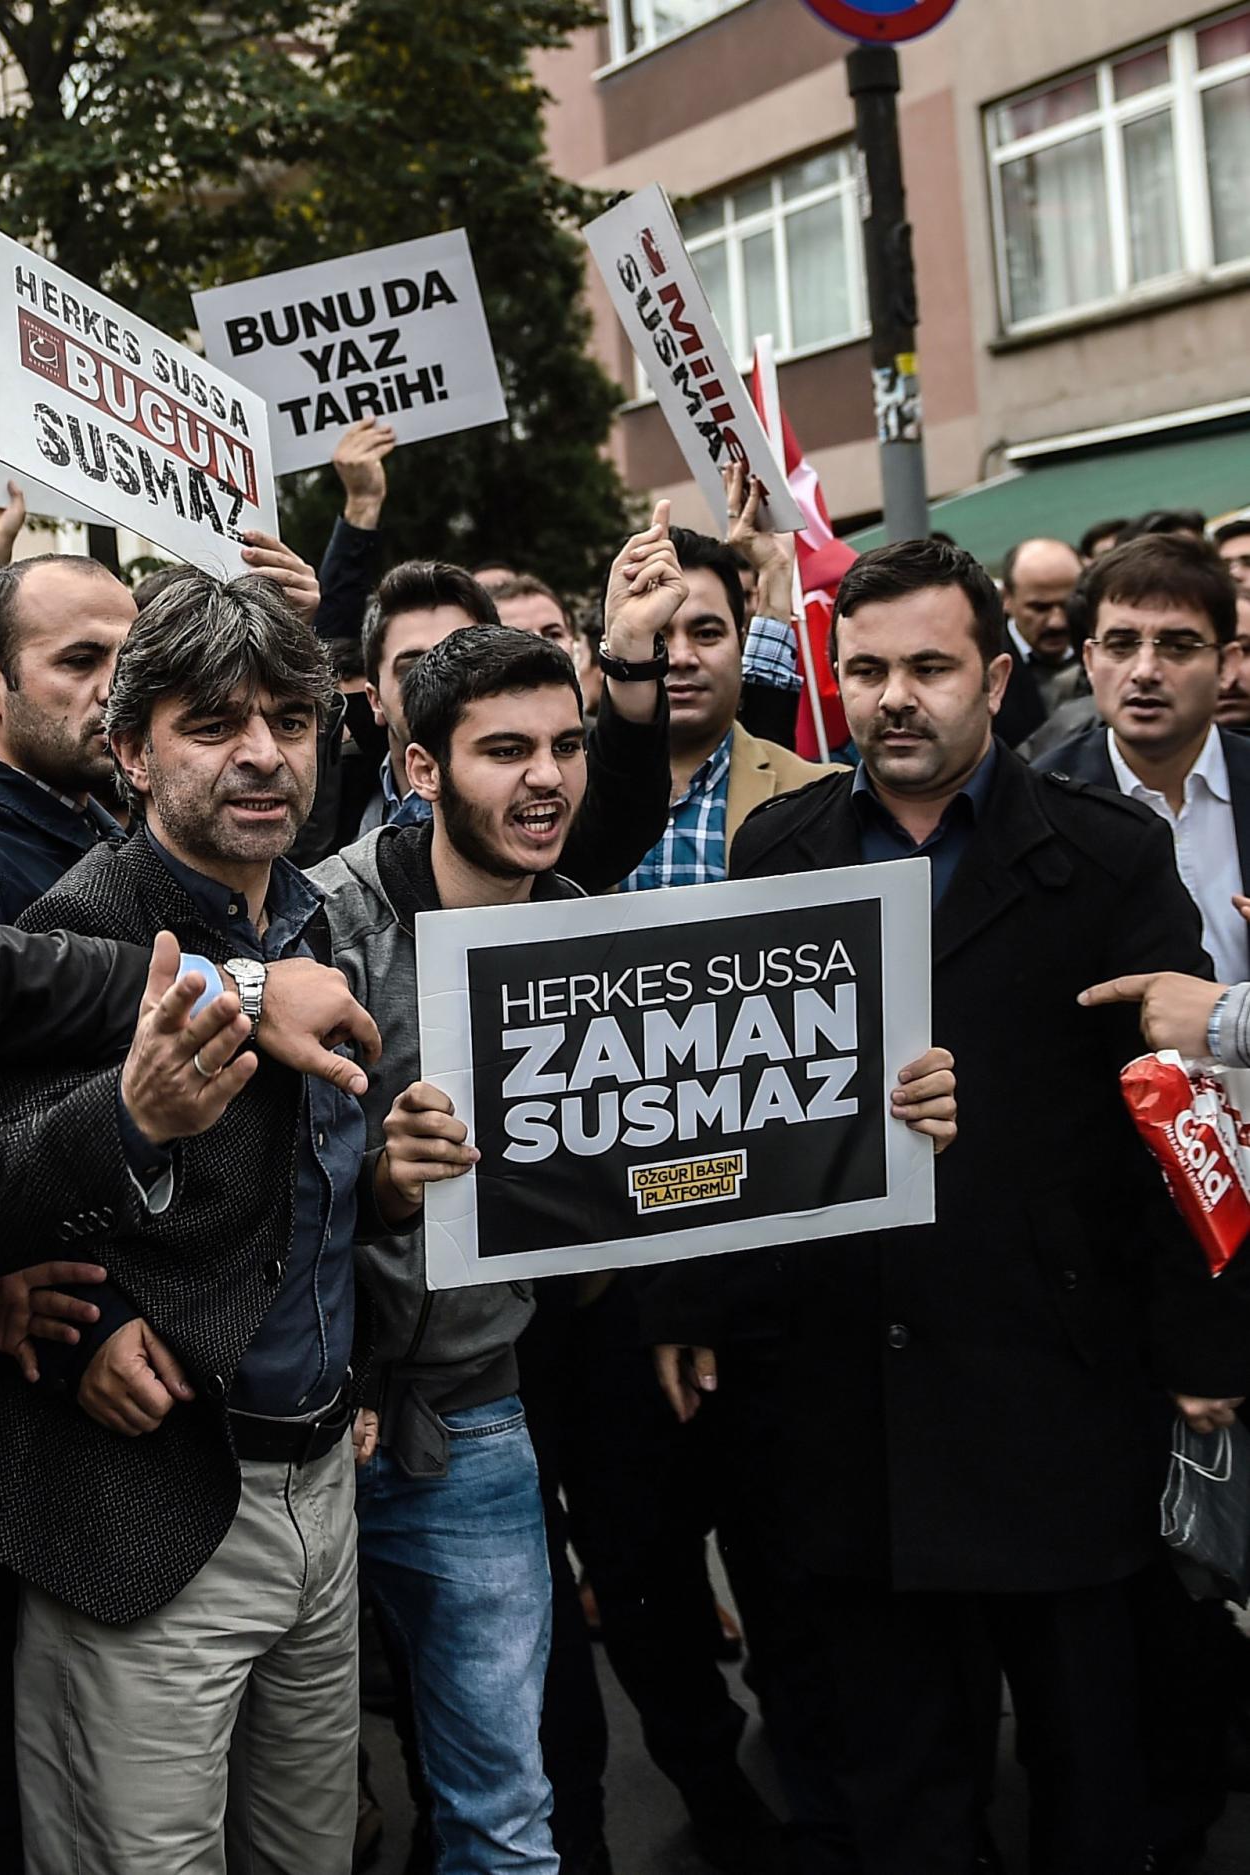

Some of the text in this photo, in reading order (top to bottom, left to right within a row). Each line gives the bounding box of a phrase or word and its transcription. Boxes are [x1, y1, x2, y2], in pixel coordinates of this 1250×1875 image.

[14, 264, 250, 438] HERKES SUSSA
[224, 269, 458, 357] BUNU DA
[299, 328, 407, 384] YAZ
[617, 253, 730, 476] SUSMA
[64, 337, 249, 494] BUGÜN
[34, 402, 253, 548] SUSMAZ
[500, 938, 857, 1025] HERKES SUSSA
[502, 981, 857, 1099] ZAMAN
[502, 1055, 859, 1163] SUSMAZ
[636, 1159, 738, 1186] ÖZGÜR BASIN
[645, 1178, 731, 1203] PLATFORMU
